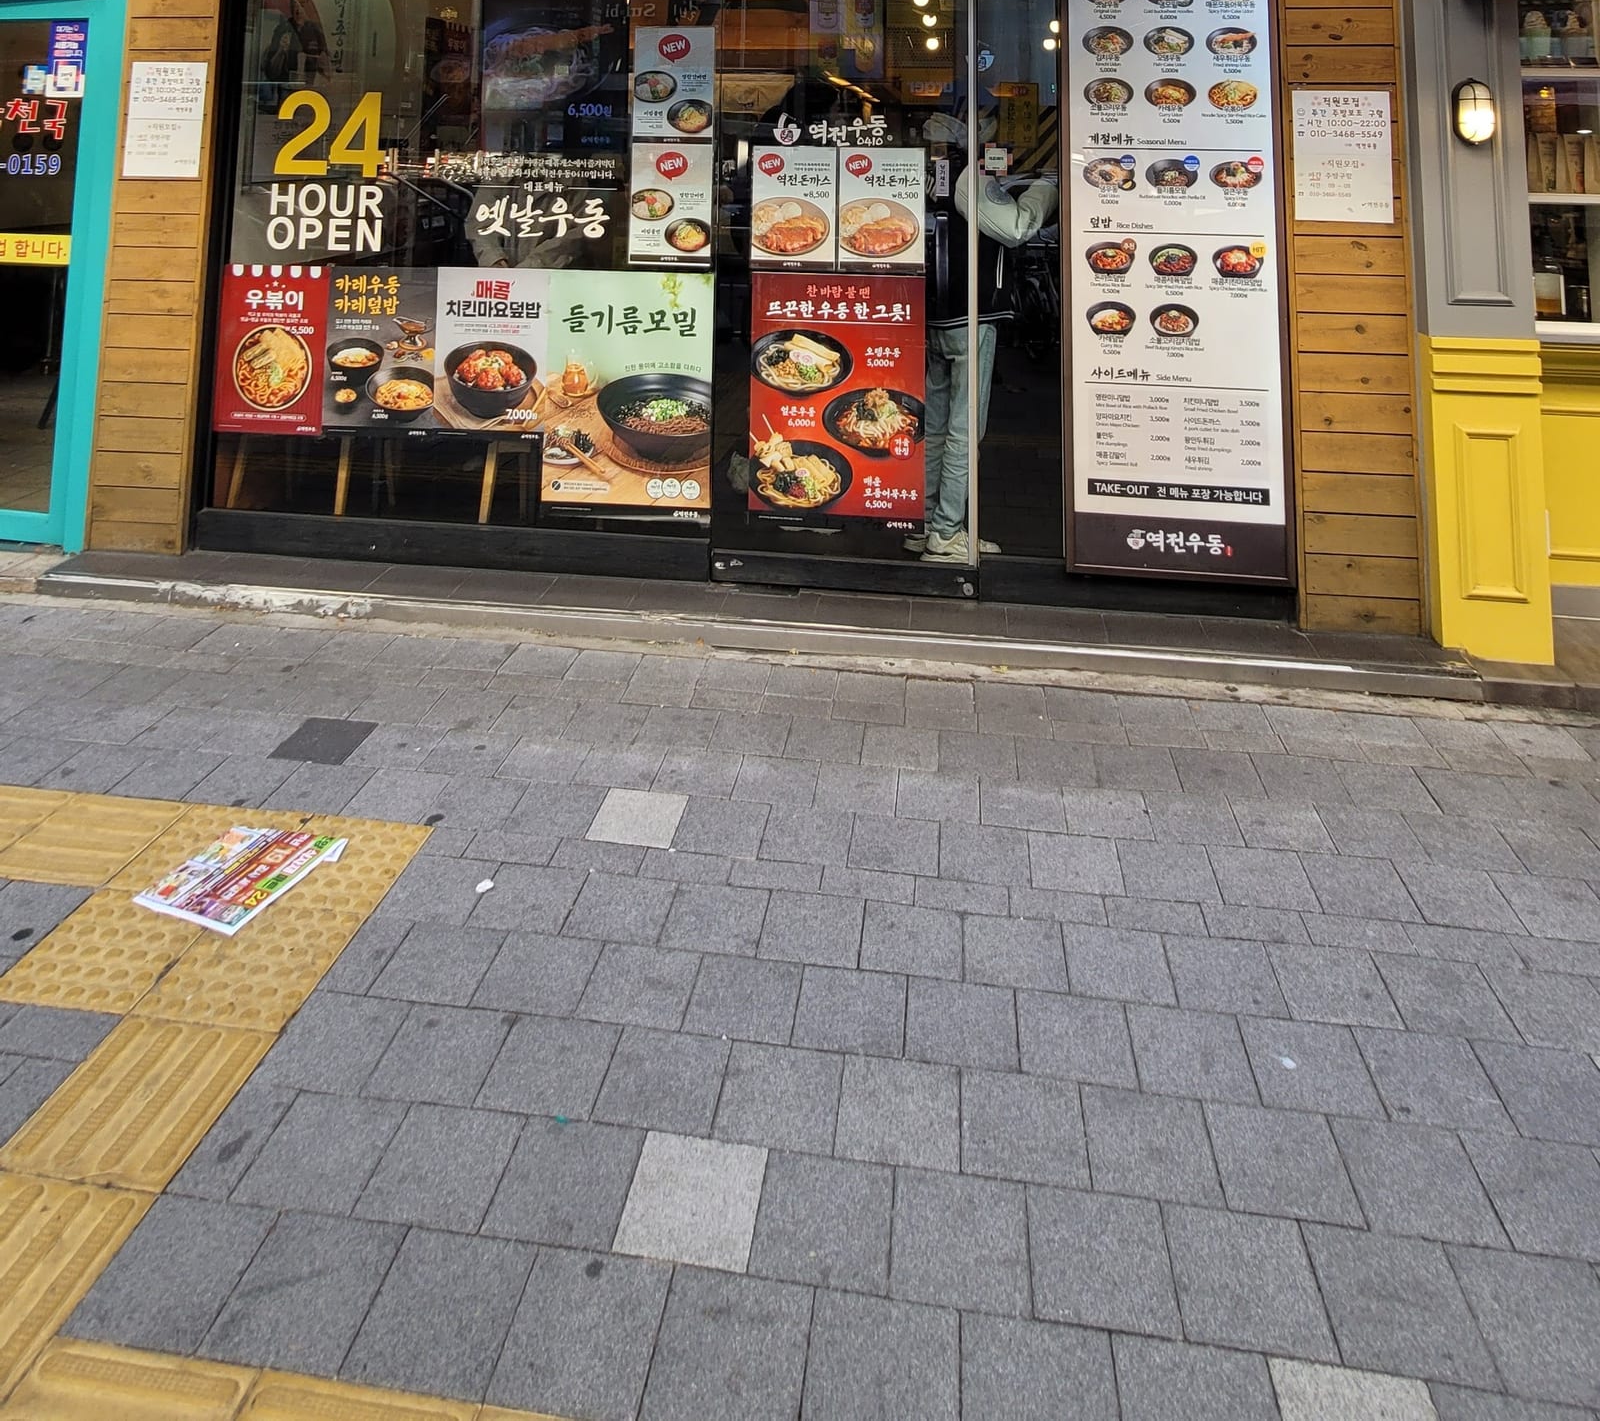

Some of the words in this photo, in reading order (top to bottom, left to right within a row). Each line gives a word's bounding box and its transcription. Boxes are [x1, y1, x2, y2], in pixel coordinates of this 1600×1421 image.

[662, 39, 686, 54] NEW
[567, 103, 613, 118] 6,500원
[1322, 96, 1360, 108] 직원모집
[0, 98, 69, 140] 천국
[1307, 119, 1322, 128] 시간
[274, 89, 387, 178] 24
[808, 115, 888, 147] 역전우동
[1088, 132, 1135, 146] 계절메뉴
[857, 137, 884, 146] 0410
[660, 157, 683, 172] NEW
[762, 158, 781, 170] NEW
[848, 159, 868, 172] NEW
[523, 182, 565, 193] 대표메뉴
[776, 173, 833, 187] 역전돈까스
[864, 174, 921, 188] 역전돈까스
[270, 182, 384, 219] HOUR
[475, 194, 611, 239] 옛날우동
[1090, 216, 1113, 229] 덮밥
[1131, 222, 1154, 230] Dishes
[266, 216, 383, 252] OPEN
[15, 239, 68, 260] 합니다.
[335, 274, 401, 295] 카레우동
[475, 279, 511, 301] 매콤
[806, 284, 817, 298] 찬
[820, 285, 843, 299] 바람
[244, 289, 304, 311] 우볶이
[334, 294, 400, 315] 카레덮밥
[445, 299, 542, 319] 치킨마요덮밥
[562, 303, 697, 338] 들기름모밀
[765, 299, 815, 318] 뜨끈한
[817, 300, 850, 320] 우동
[853, 302, 870, 320] 한
[872, 303, 911, 322] 그릇!
[1091, 366, 1151, 381] 사이드메뉴
[1094, 482, 1150, 496] TAKE-OUT
[1157, 486, 1167, 498] 전
[1169, 486, 1189, 500] 메뉴
[1191, 488, 1211, 500] 포장
[1213, 489, 1263, 504] 가능합니다
[1146, 529, 1225, 556] 역전우동
